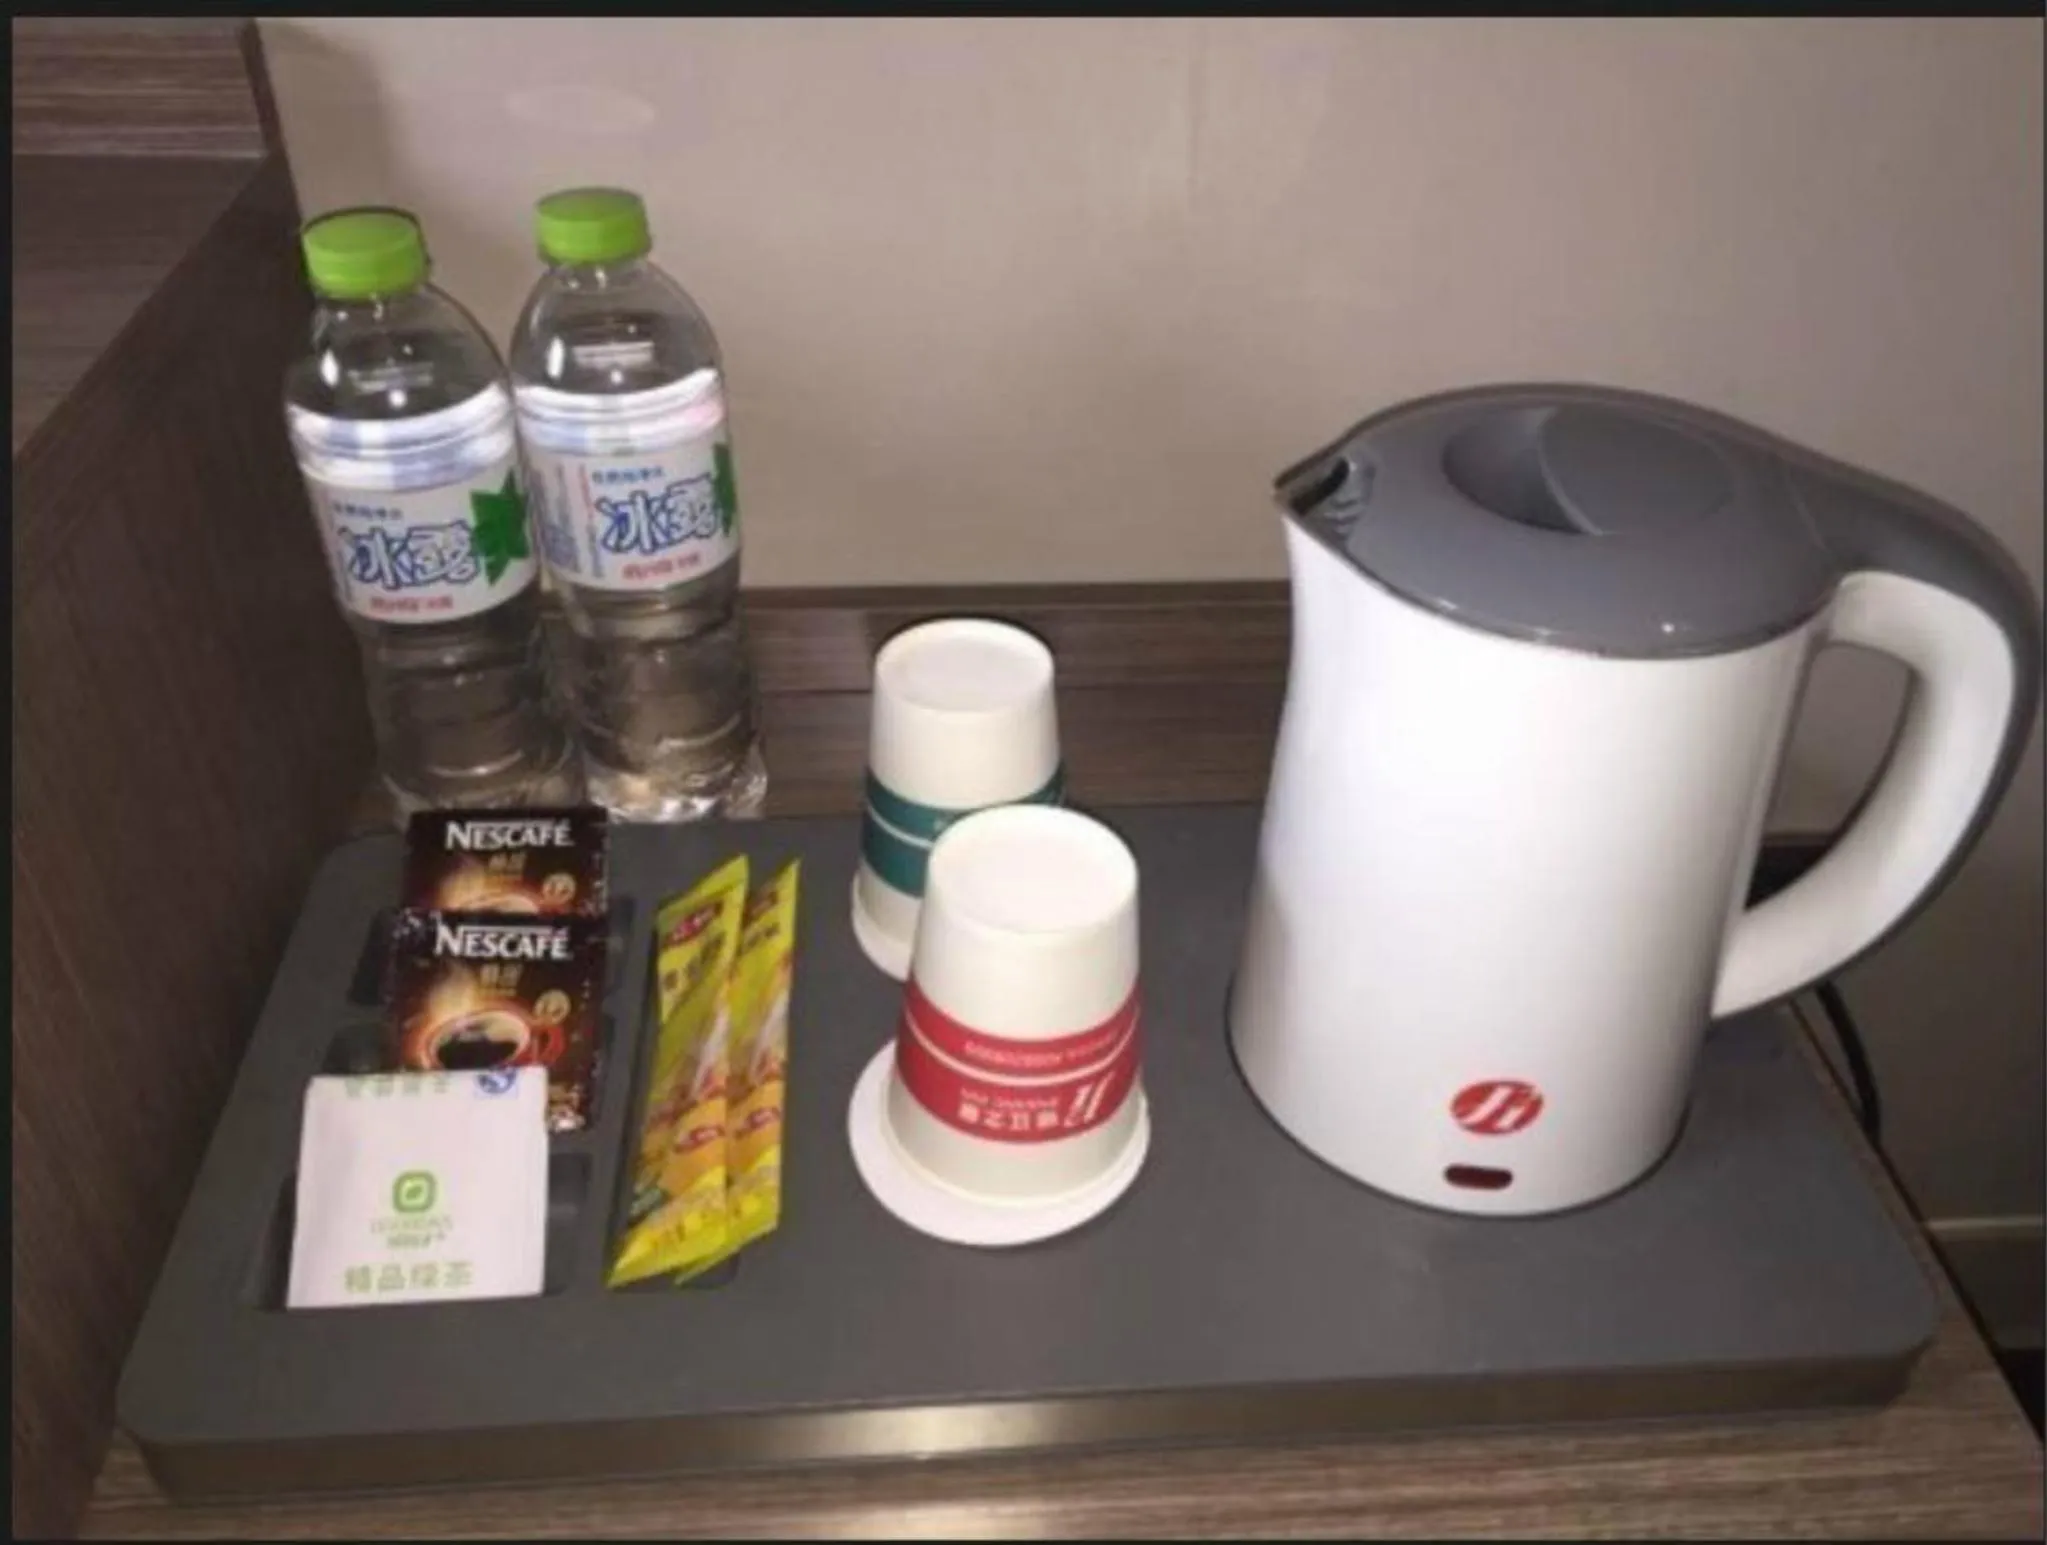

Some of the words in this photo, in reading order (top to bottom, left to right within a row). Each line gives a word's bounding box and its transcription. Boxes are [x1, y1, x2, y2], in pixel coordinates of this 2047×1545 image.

[595, 472, 718, 556] 冰露
[337, 519, 478, 591] 冰露
[445, 817, 574, 850] NESCAFÉ
[433, 920, 573, 961] NESCAFÉ
